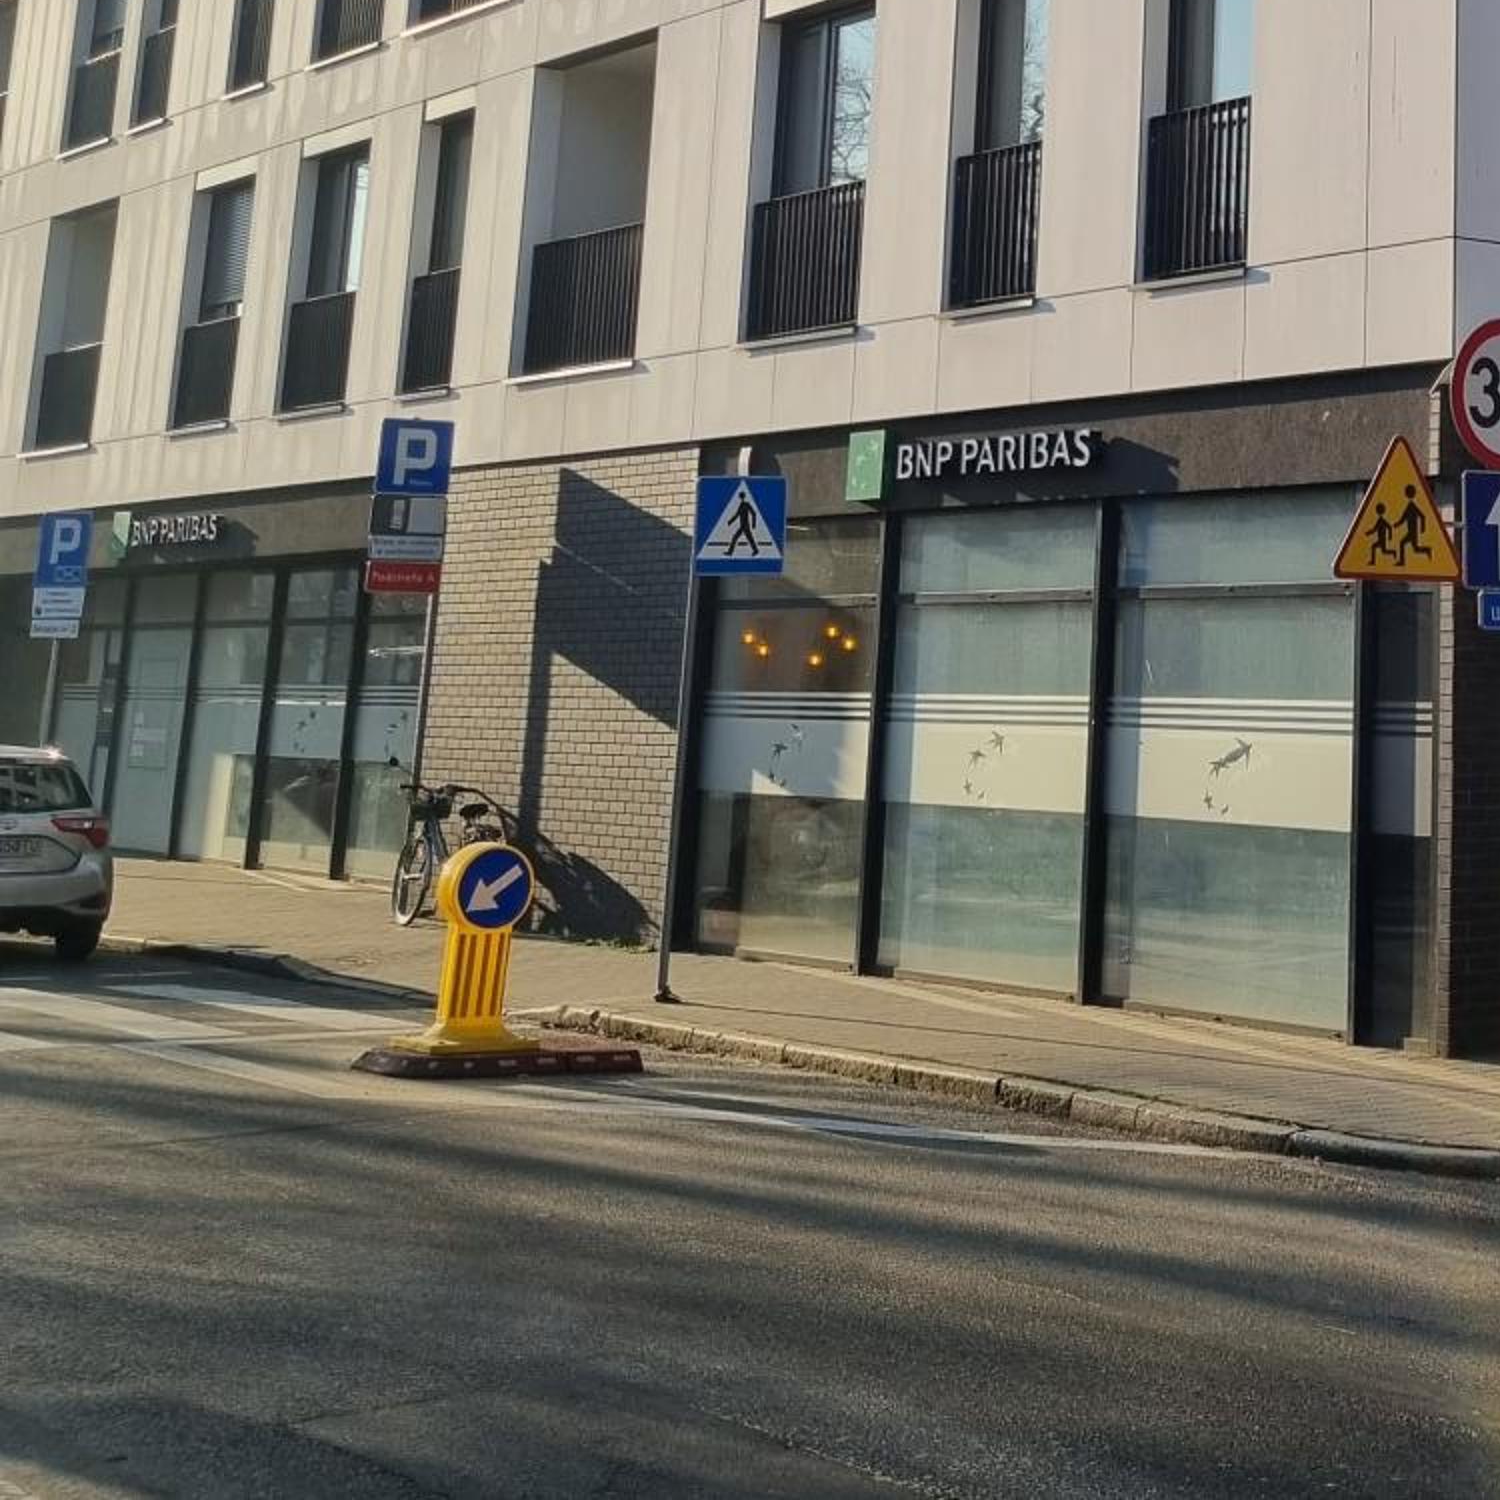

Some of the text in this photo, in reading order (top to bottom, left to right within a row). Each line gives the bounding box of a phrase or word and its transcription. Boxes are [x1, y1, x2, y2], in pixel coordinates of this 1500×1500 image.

[392, 428, 437, 485] P
[896, 429, 1090, 479] BNP PARIBAS
[49, 519, 82, 565] P
[131, 514, 217, 547] BNP PARIBAS
